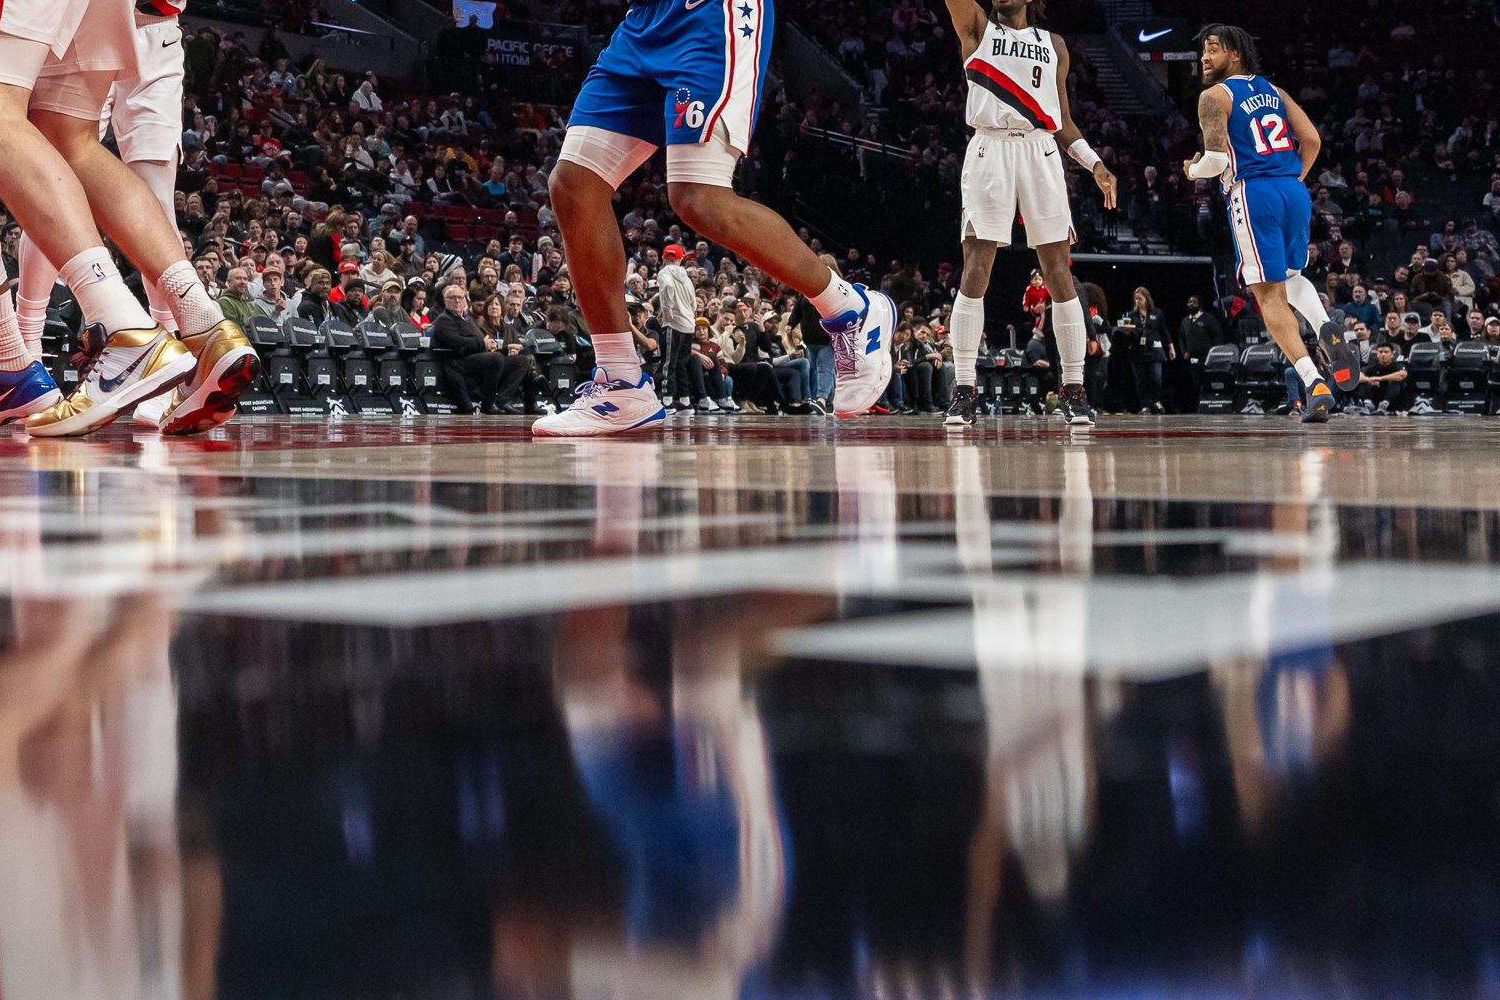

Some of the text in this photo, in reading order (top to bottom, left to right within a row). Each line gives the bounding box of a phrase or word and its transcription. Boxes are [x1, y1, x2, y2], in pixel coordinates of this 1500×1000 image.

[487, 38, 530, 54] PACIFIC
[992, 38, 1050, 64] BLAZERS
[1031, 66, 1042, 88] 9
[674, 101, 705, 128] 76
[1250, 113, 1293, 155] 12
